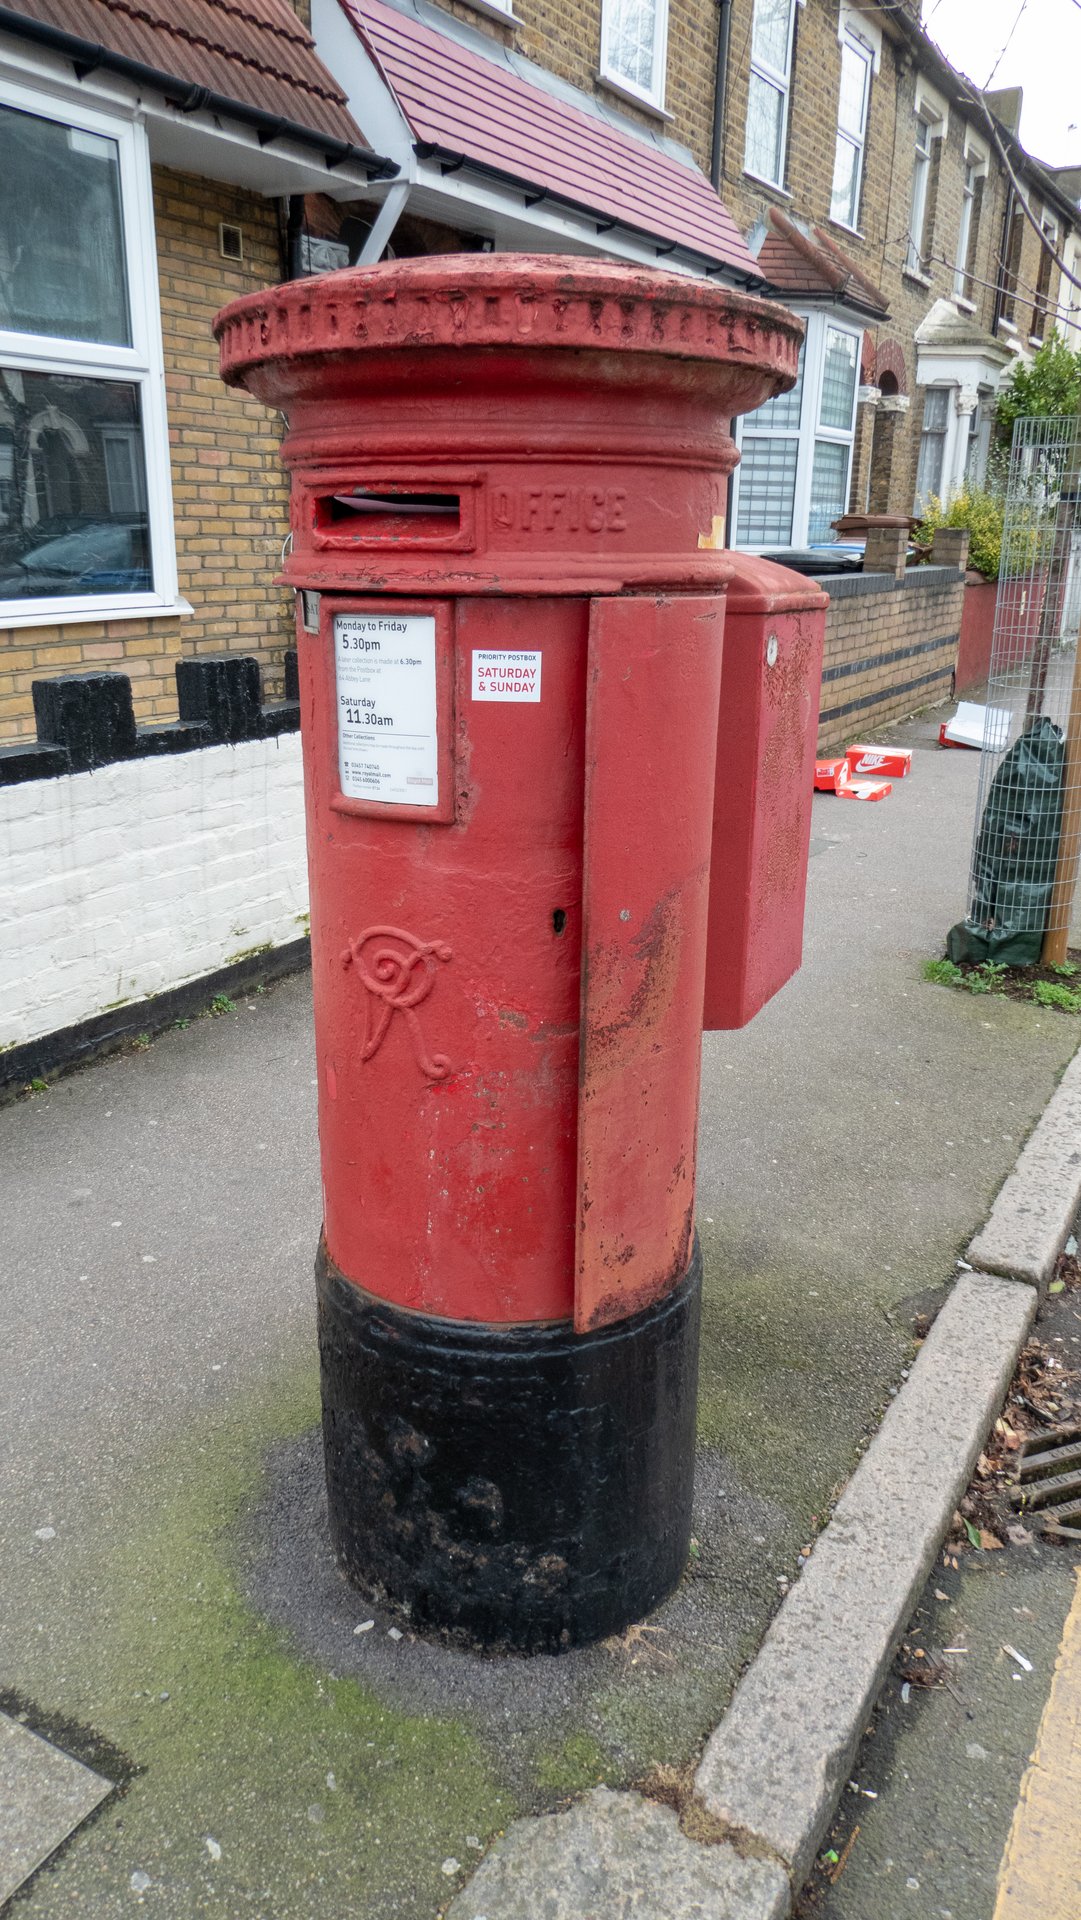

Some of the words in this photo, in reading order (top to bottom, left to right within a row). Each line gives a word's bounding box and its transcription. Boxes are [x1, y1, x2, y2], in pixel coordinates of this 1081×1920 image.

[491, 485, 628, 535] OFFICE
[336, 620, 366, 634] Monday
[367, 621, 377, 631] to
[379, 621, 407, 632] Friday
[342, 634, 381, 651] 5.30pm
[400, 658, 422, 666] 6.30pm
[478, 667, 537, 679] SATURDAY
[478, 681, 486, 691] &
[490, 681, 535, 692] SUNDAY
[340, 696, 376, 709] Saturday
[346, 709, 394, 726] 11.30am
[861, 754, 885, 764] NIKE
